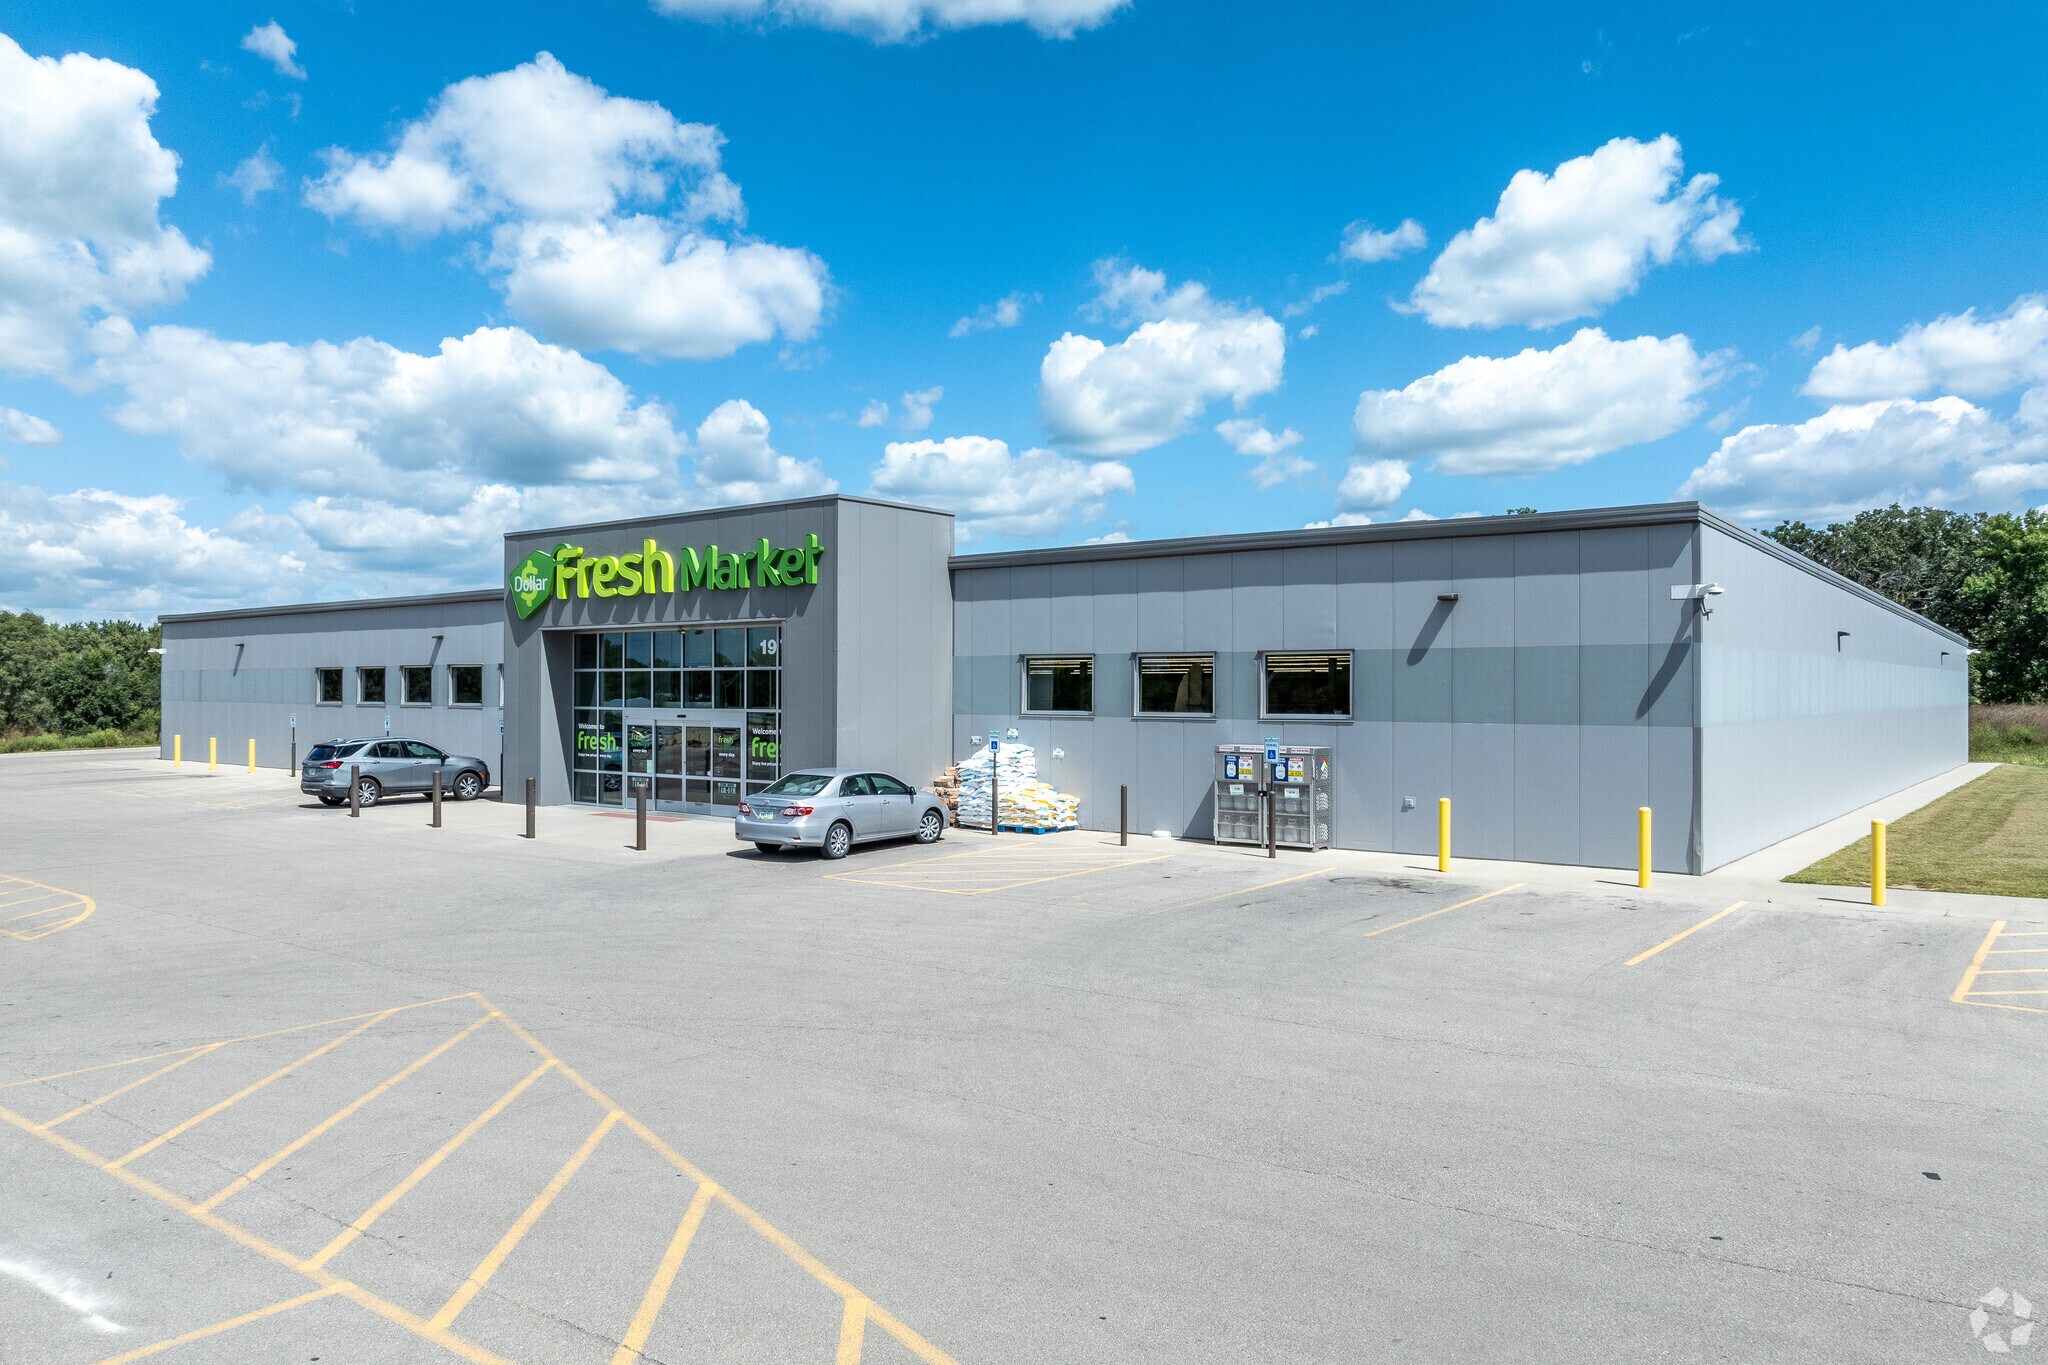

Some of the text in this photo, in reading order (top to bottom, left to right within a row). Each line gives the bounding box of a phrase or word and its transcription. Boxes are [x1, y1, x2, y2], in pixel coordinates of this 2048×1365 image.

[554, 533, 825, 600] Fresh Market
[514, 575, 549, 592] Dollar
[760, 639, 782, 655] 19
[751, 736, 782, 759] fre
